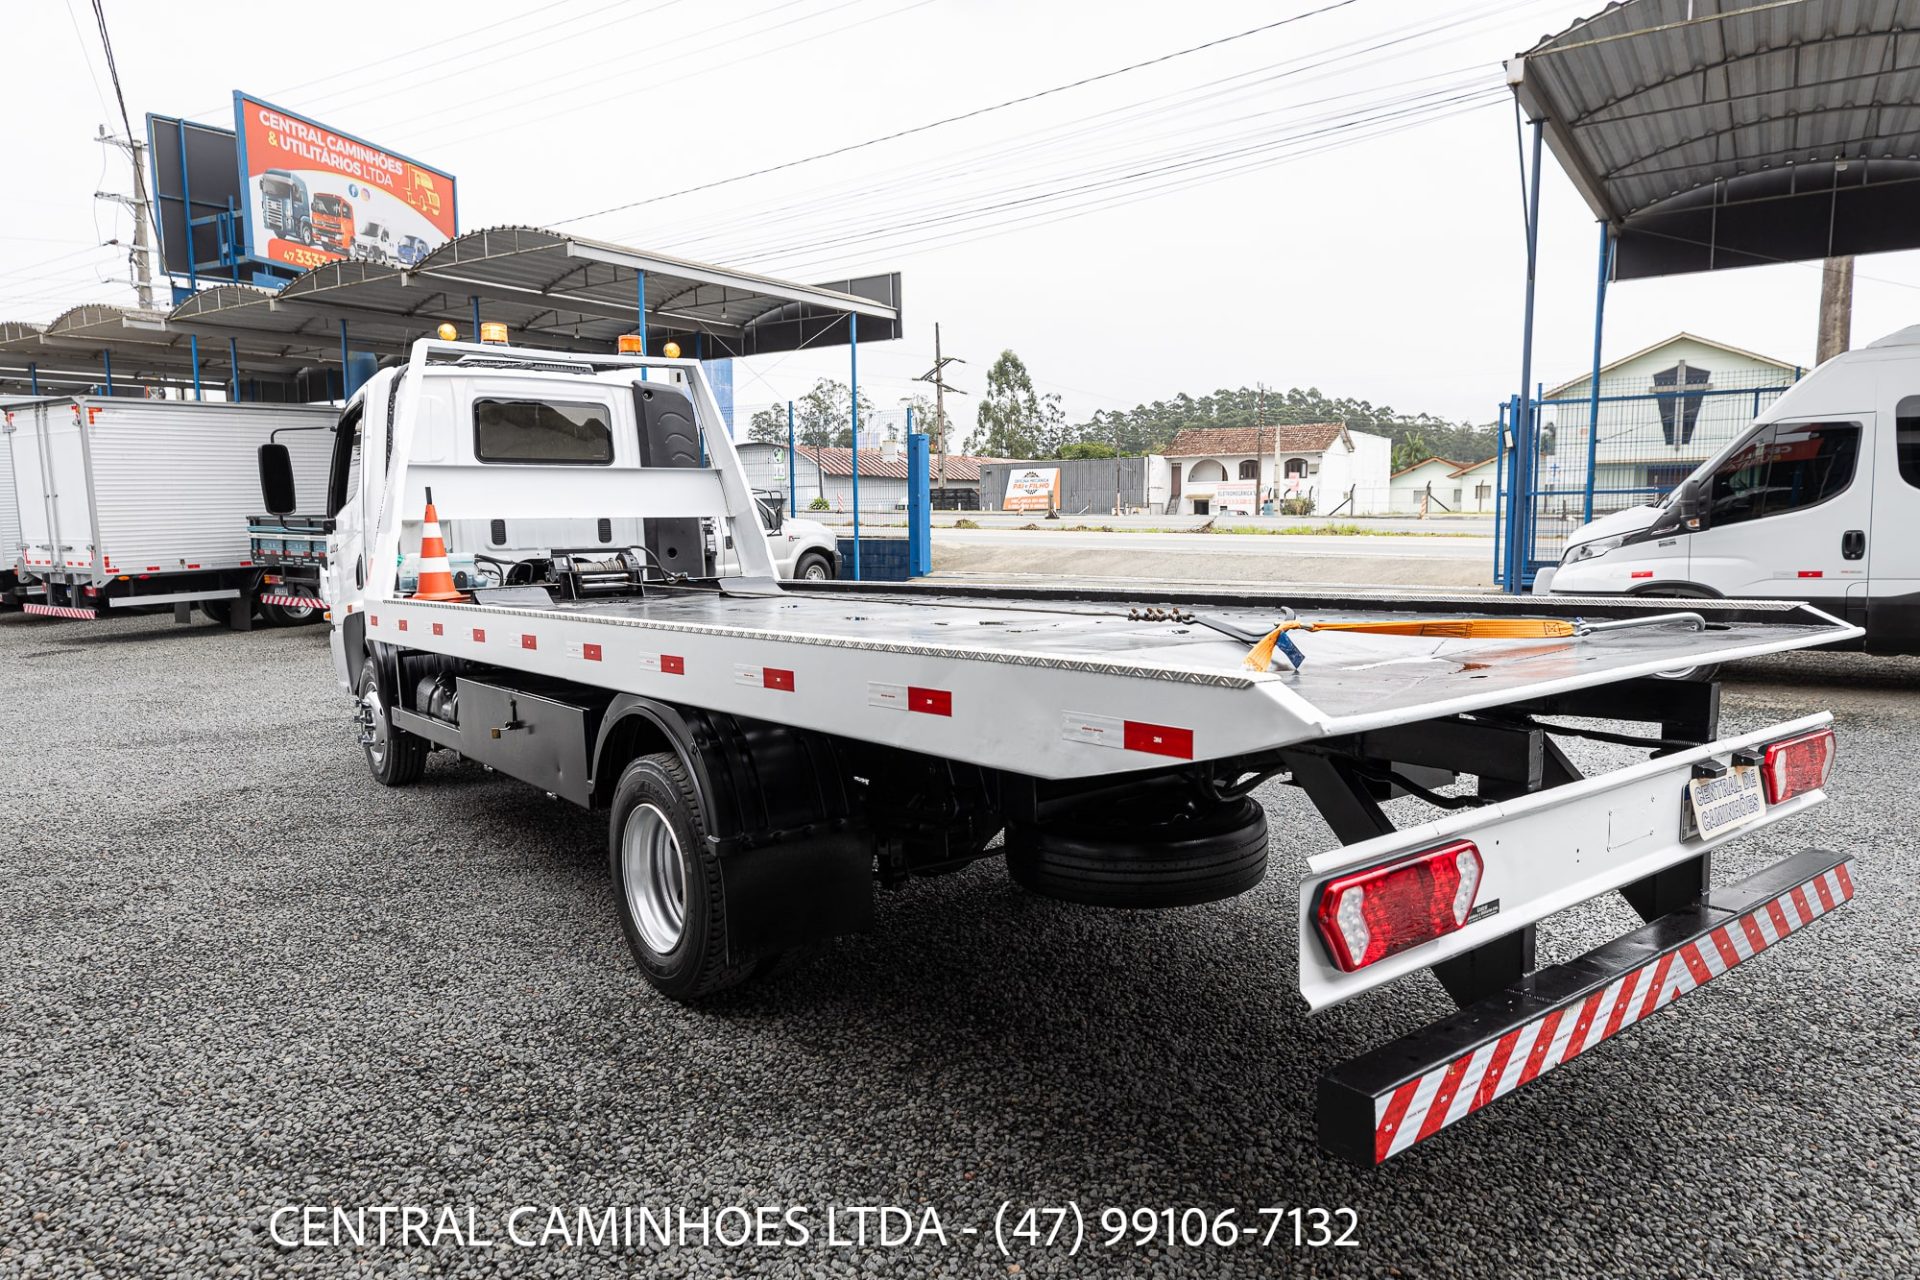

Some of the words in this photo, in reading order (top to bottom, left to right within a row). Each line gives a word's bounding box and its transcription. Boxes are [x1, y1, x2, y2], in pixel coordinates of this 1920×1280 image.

[258, 110, 325, 147] CENTRAL
[326, 136, 403, 175] CAMINHÕES
[268, 131, 278, 147] &
[279, 134, 361, 175] UTILITÁRIOS
[363, 166, 393, 187] LTDA
[283, 250, 295, 261] 47
[1695, 775, 1742, 806] CENTRAL
[1742, 768, 1757, 790] DE
